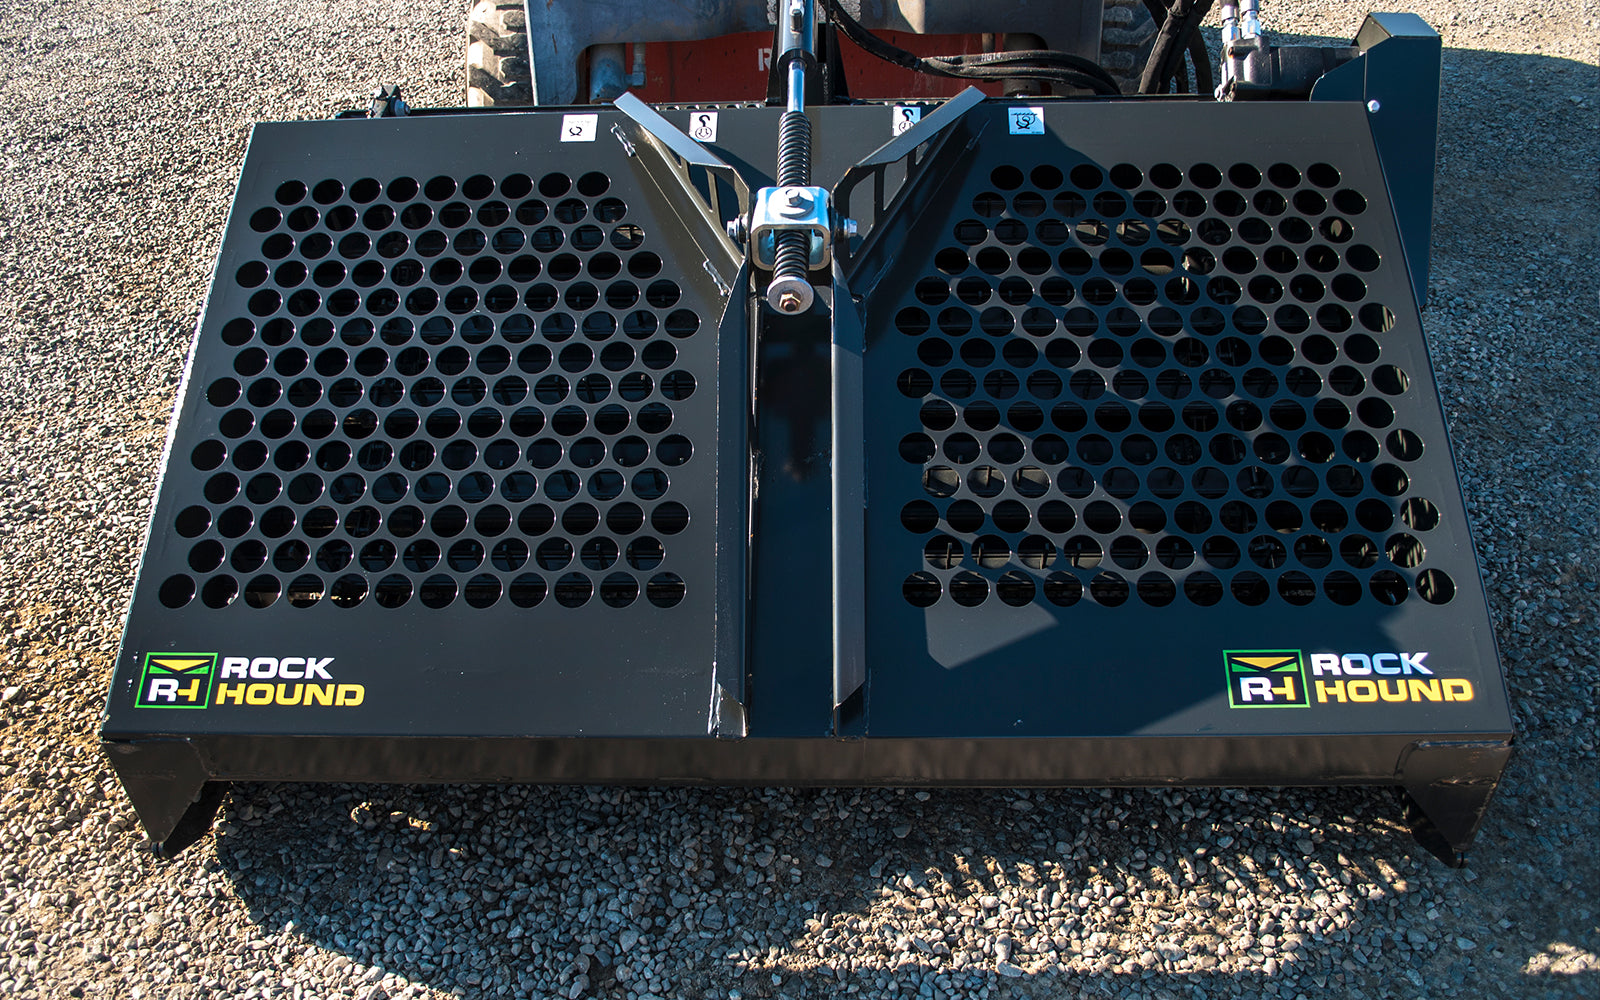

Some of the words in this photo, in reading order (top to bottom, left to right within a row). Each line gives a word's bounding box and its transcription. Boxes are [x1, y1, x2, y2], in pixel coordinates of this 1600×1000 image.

[220, 656, 335, 680] ROCK
[1310, 652, 1434, 676] ROCK
[216, 683, 365, 706] HOUND
[1315, 678, 1474, 703] HOUND
